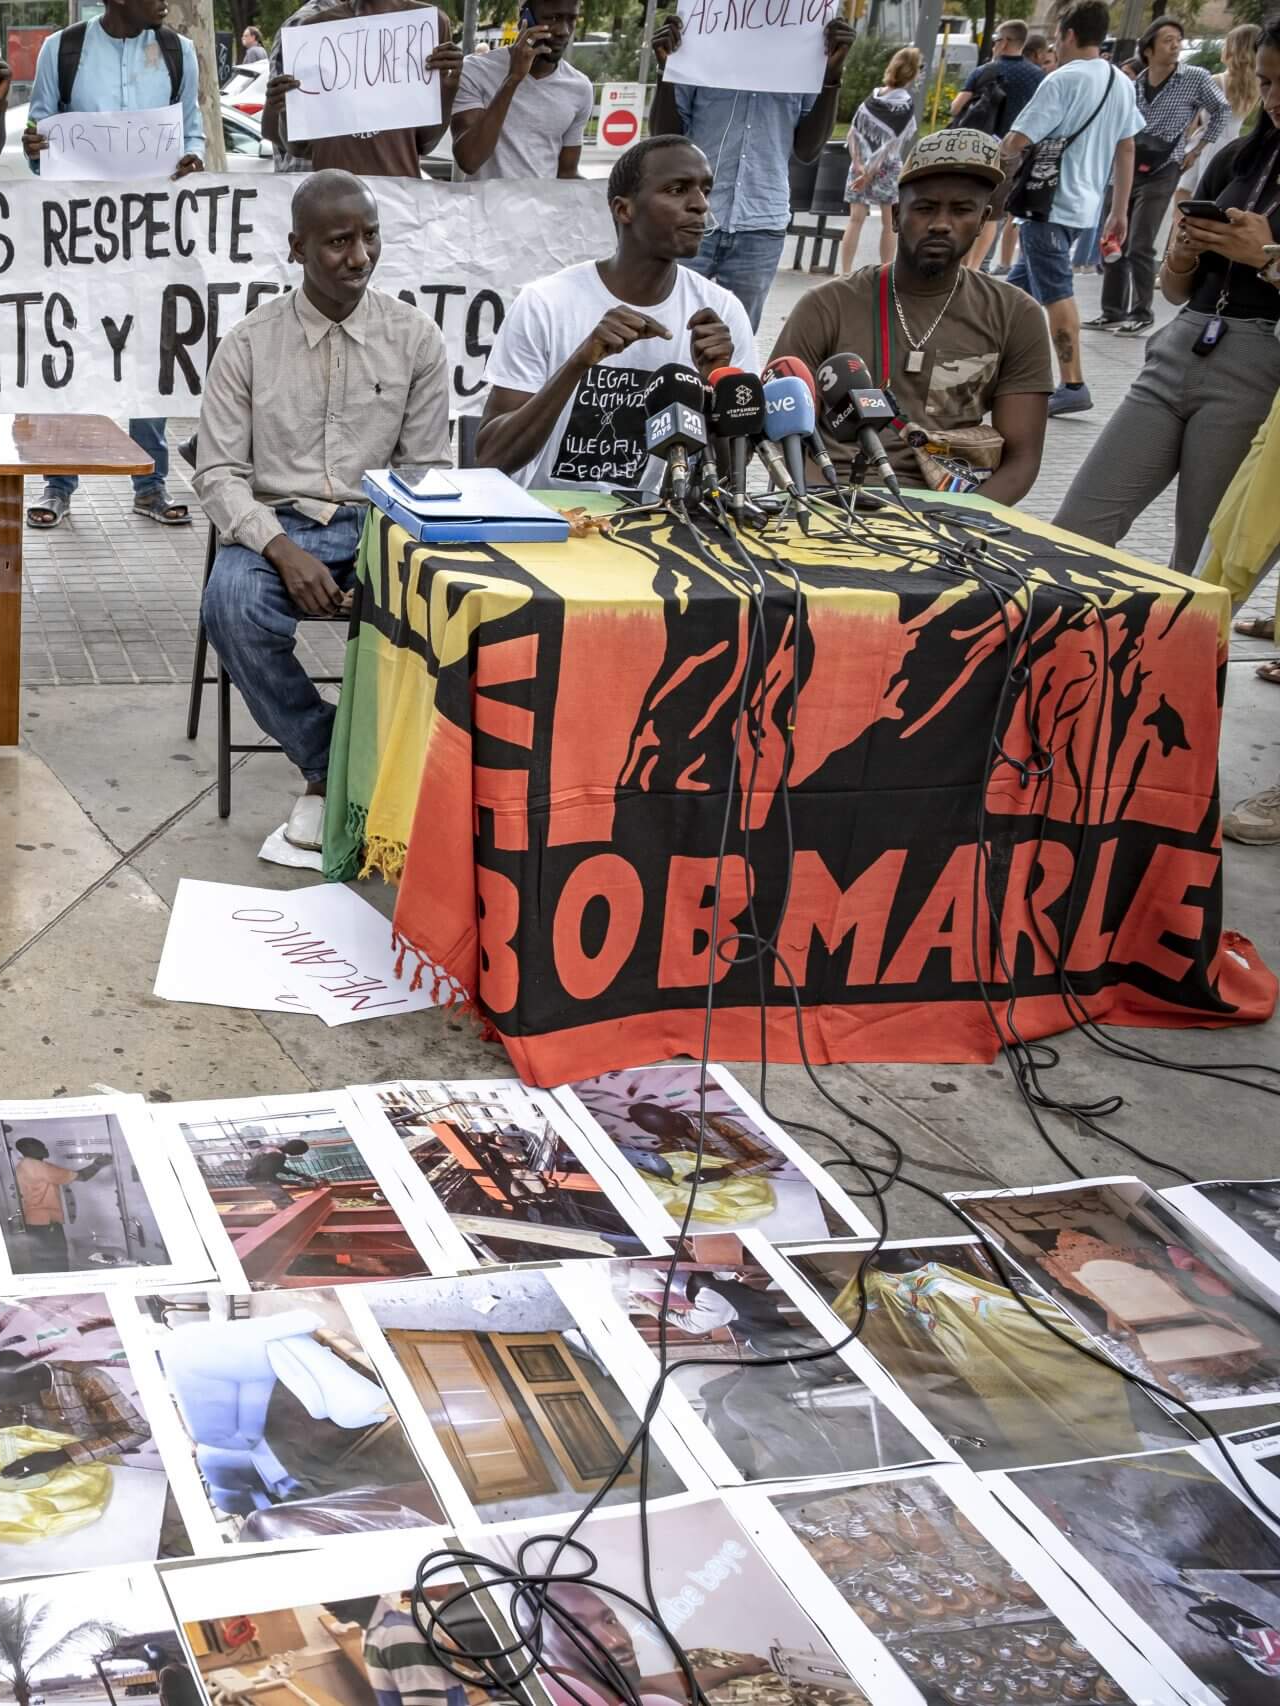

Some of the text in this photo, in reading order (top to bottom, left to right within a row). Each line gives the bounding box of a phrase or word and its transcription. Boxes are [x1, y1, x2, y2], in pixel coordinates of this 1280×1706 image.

[293, 20, 435, 95] COSTURERO
[43, 185, 258, 269] RESPECTE
[586, 368, 640, 388] LEGAL
[644, 376, 664, 399] acn
[675, 373, 703, 388] acn
[818, 365, 838, 392] 3
[651, 412, 672, 433] 20
[682, 410, 702, 428] 20
[652, 424, 672, 441] anys
[557, 462, 637, 480] PEOPLE
[774, 838, 1221, 986] MARLE
[231, 909, 409, 1011] MECANICO
